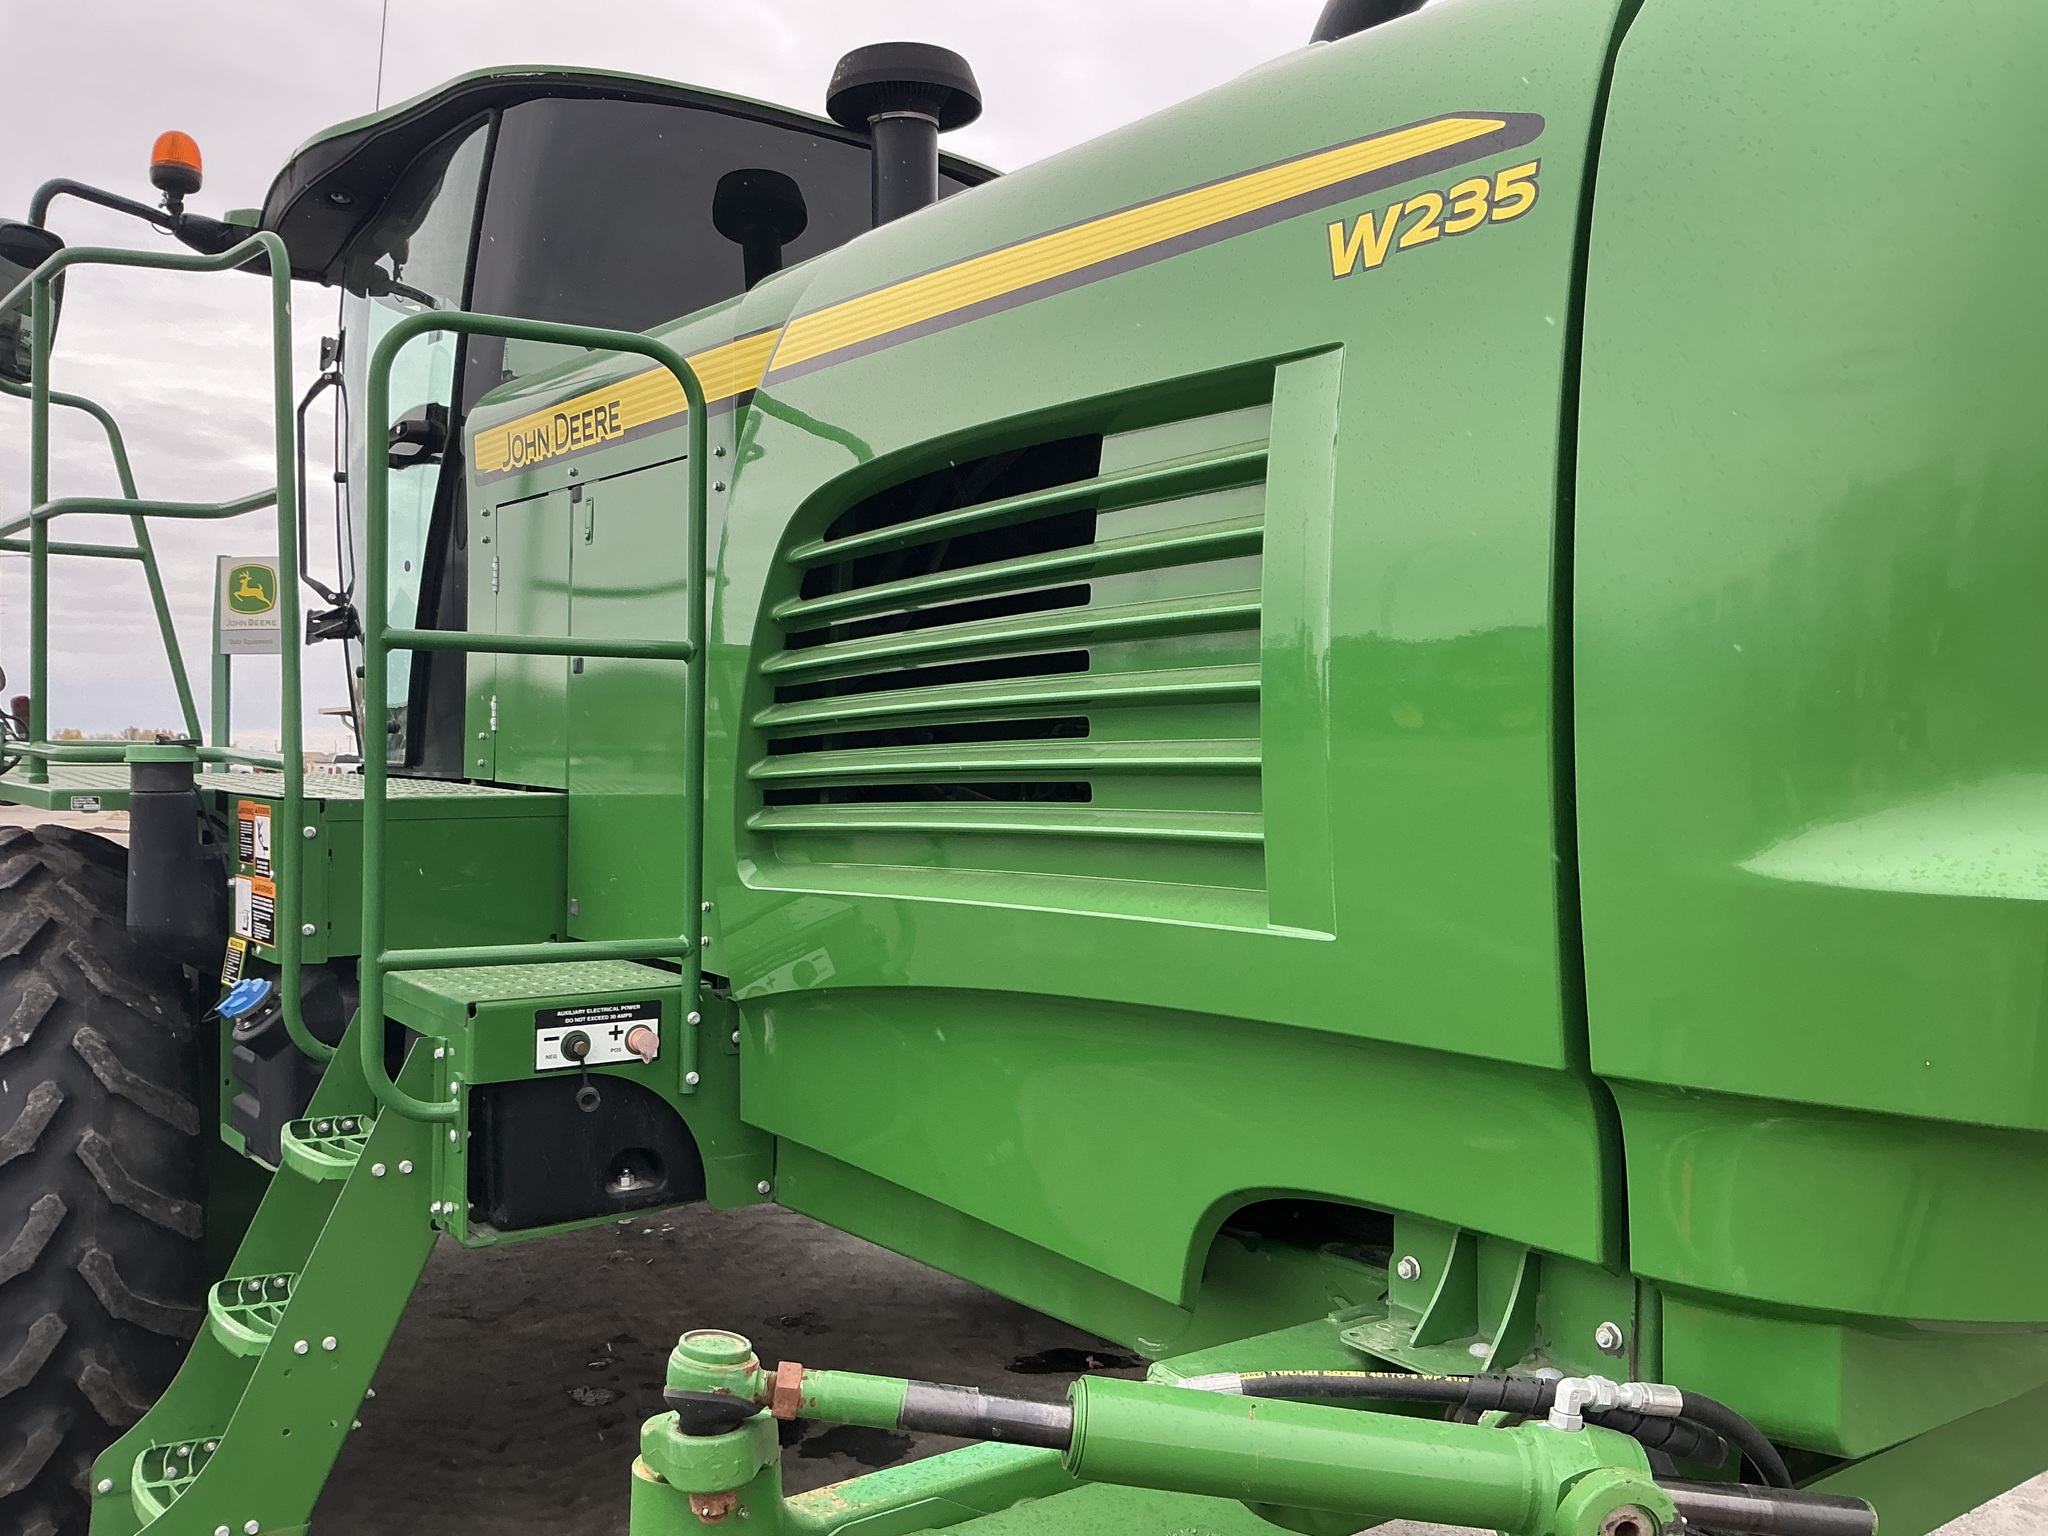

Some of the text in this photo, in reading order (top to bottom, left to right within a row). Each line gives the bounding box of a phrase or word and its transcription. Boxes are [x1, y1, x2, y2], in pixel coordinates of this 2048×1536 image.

[1328, 159, 1540, 279] W235
[502, 400, 622, 468] JOHN DEERE
[226, 618, 277, 627] JOHN DEERE
[557, 1008, 586, 1017] AUXILIARY
[586, 1006, 620, 1014] ELECTRICAL
